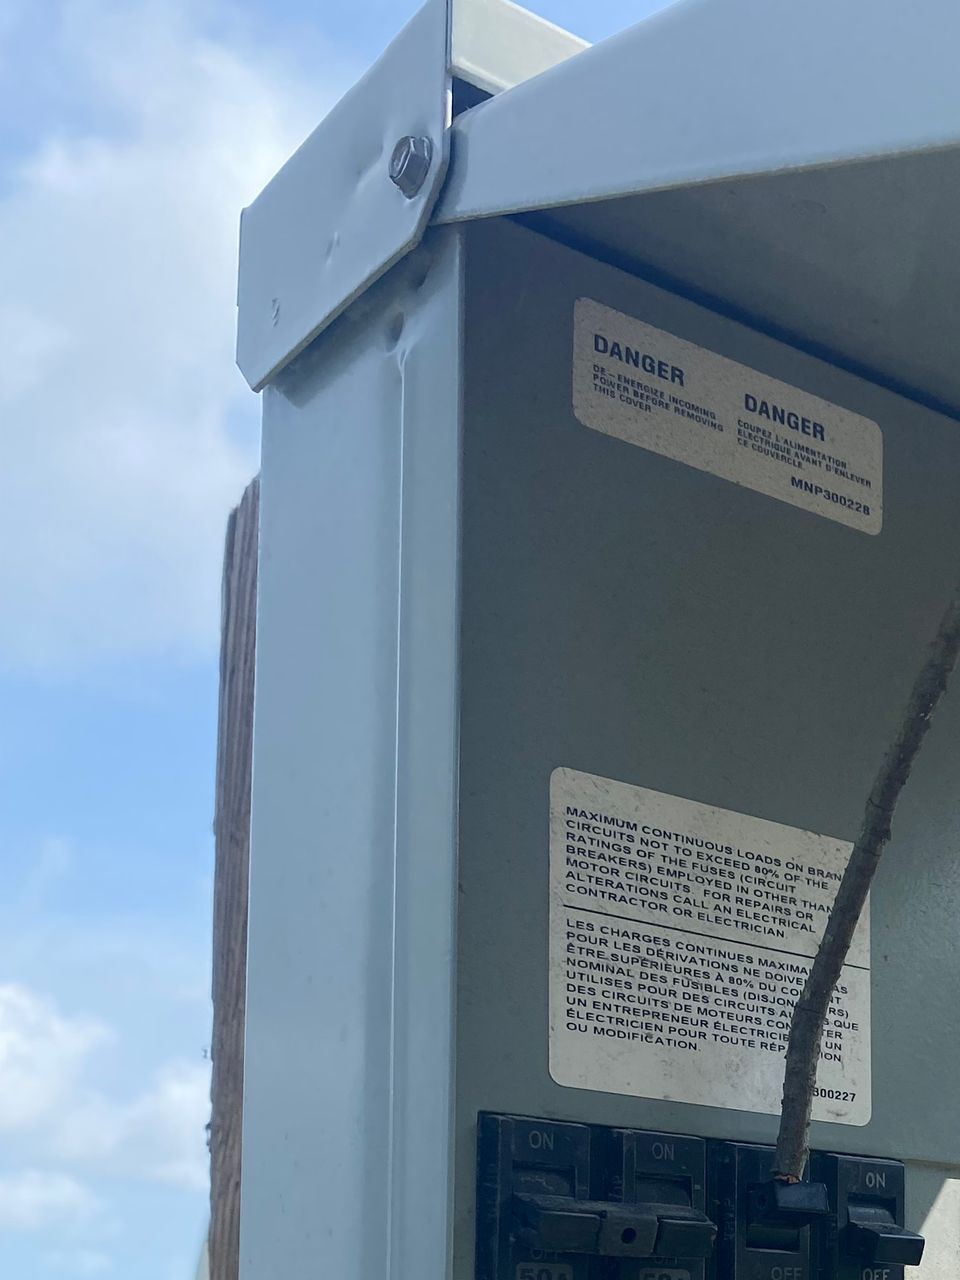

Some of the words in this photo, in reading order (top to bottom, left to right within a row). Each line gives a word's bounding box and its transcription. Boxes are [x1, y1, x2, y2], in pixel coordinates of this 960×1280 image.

[594, 333, 684, 387] DANGER
[593, 382, 616, 399] THIS
[619, 394, 652, 413] COVER
[593, 373, 629, 394] POWER
[633, 389, 670, 411] BEFORE
[674, 406, 724, 432] REMOVING
[669, 394, 716, 420] INCOMING
[744, 393, 825, 442] DANGER
[737, 418, 772, 439] COUPEZ
[737, 437, 748, 448] CE
[737, 428, 791, 456] ELECTRIQUE
[794, 451, 822, 468] AVANT
[790, 475, 870, 516] MNP300228
[566, 806, 638, 831] MAXIMUM
[642, 825, 733, 855] CONTINUOUS
[737, 849, 781, 867] LOADS
[785, 861, 803, 872] ON
[808, 866, 843, 884] BRAN
[566, 820, 635, 843] CIRCUITS
[640, 837, 669, 851] NOT
[674, 845, 692, 857] TO
[697, 851, 750, 871] EXCEED
[755, 865, 779, 878] 80%
[784, 873, 802, 883] OF
[805, 877, 829, 890] THE
[566, 831, 631, 855] RATINGS
[636, 849, 655, 860] OF
[660, 854, 687, 868] THE
[692, 862, 735, 879] FUSES
[740, 874, 796, 894] (CIRCUIT
[565, 883, 668, 914] CONTRACTOR
[672, 907, 693, 918] OR
[566, 844, 652, 874] BREAKERS)
[657, 866, 732, 890] EMPLOYED
[737, 885, 749, 895] IN
[753, 889, 797, 906] OTHER
[800, 899, 835, 917] THAN
[566, 856, 620, 877] MOTOR
[703, 889, 731, 903] FOR
[735, 896, 791, 916] REPAIRS
[796, 911, 814, 922] OR
[565, 871, 668, 900] ALTERATIONS
[673, 895, 709, 910] CALL
[713, 904, 731, 915] AN
[736, 908, 816, 934] ELECTRICAL
[566, 918, 594, 931] LES
[600, 926, 671, 947] CHARGES
[675, 941, 754, 964] CONTINUES
[566, 931, 609, 947] POUR
[614, 941, 641, 953] LES
[646, 947, 739, 973] DÉRIVATIONS
[743, 967, 760, 978] NE
[566, 942, 607, 960] ÊTRE
[610, 953, 710, 979] SUPÉRIEURES
[715, 972, 724, 983] À
[728, 976, 754, 989] 80%
[759, 982, 776, 992] DU
[566, 956, 635, 978] NOMINAL
[639, 971, 668, 984] DES
[673, 977, 738, 997] FUSIBLES
[566, 983, 596, 996] DES
[601, 990, 669, 1009] CIRCUITS
[674, 1002, 692, 1013] DE
[566, 970, 632, 990] UTILISES
[638, 983, 677, 998] POUR
[682, 992, 709, 1004] DES
[714, 998, 775, 1016] CIRCUITS
[833, 1020, 859, 1031] QUE
[566, 996, 587, 1007] UN
[592, 1001, 709, 1028] ENTREPRENEUR
[713, 1021, 791, 1044] ÉLECTRICIE
[825, 1041, 842, 1051] UN
[566, 1022, 588, 1033] OU
[566, 1008, 663, 1033] ÉLECTRICIEN
[668, 1026, 707, 1040] POUR
[712, 1033, 756, 1048] TOUTE
[529, 1131, 553, 1149] ON
[652, 1142, 674, 1160] ON
[865, 1172, 886, 1187] ON
[770, 1266, 802, 1280] OFF
